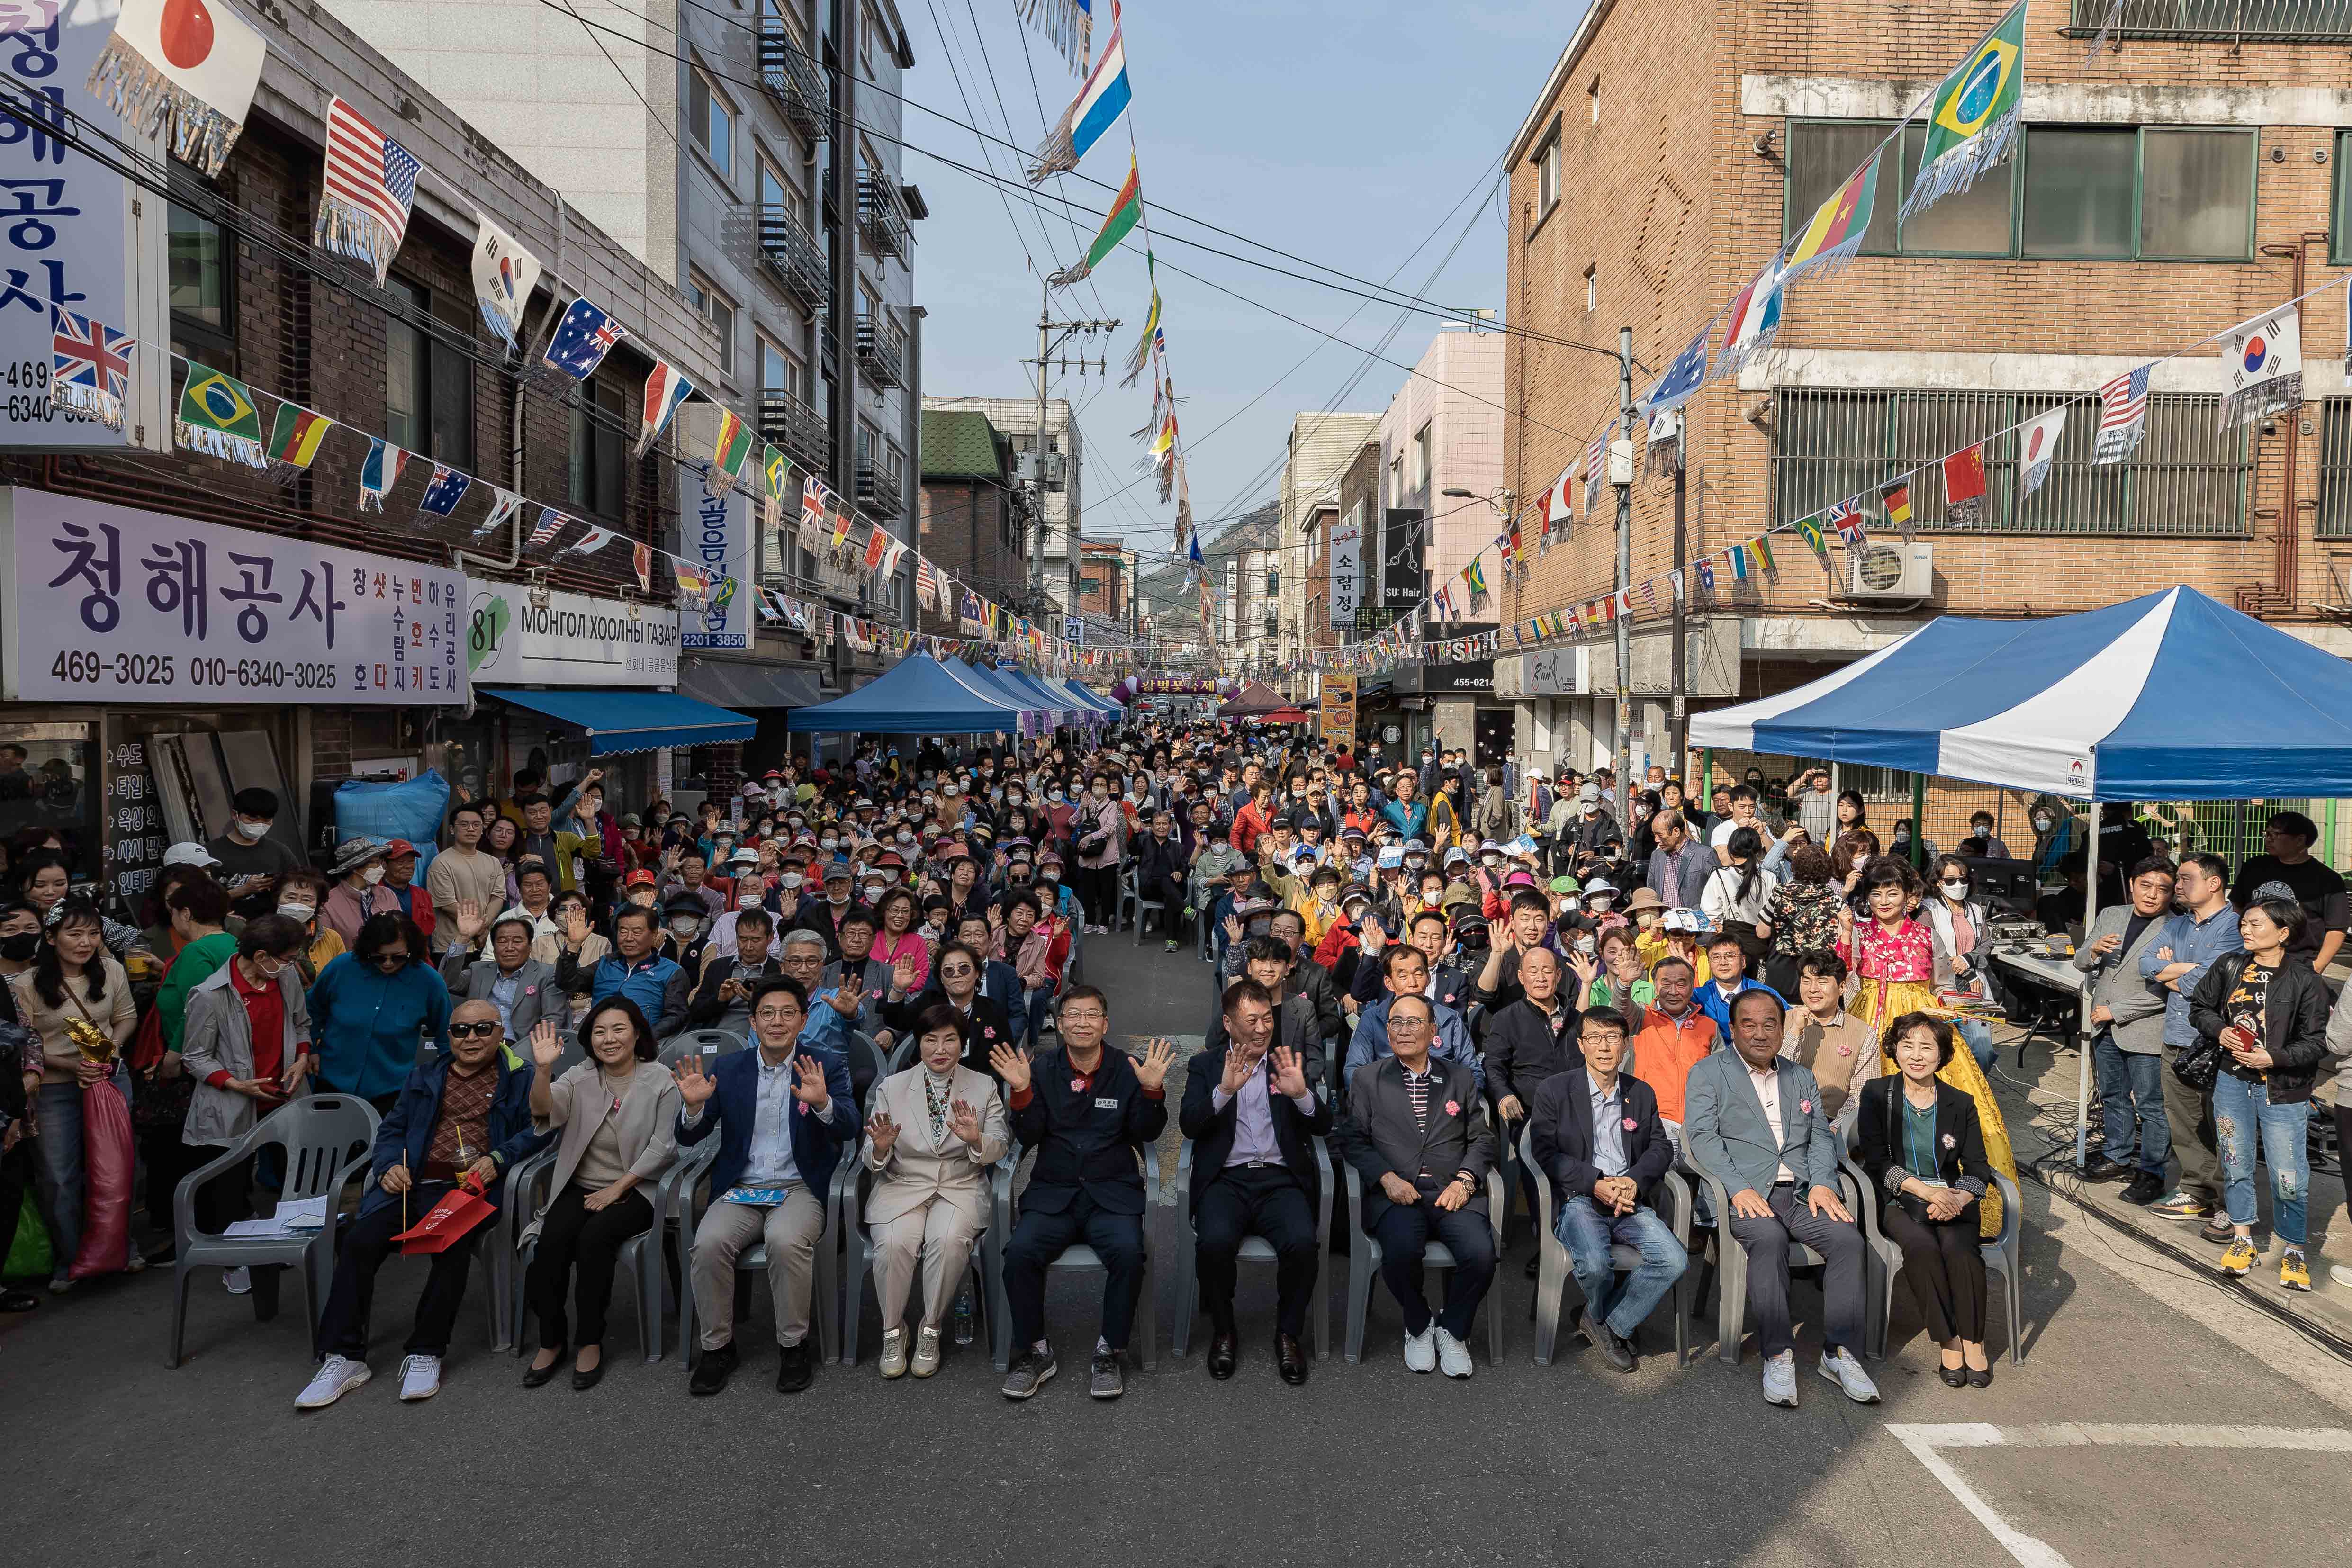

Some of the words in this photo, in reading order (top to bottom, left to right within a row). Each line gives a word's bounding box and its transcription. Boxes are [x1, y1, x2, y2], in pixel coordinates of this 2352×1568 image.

[48, 522, 345, 650] 청해공사
[1402, 587, 1421, 597] Hair
[393, 575, 405, 691] 누수탐지
[411, 578, 423, 691] 번호키
[429, 581, 440, 690] 하수도
[445, 583, 457, 693] 유리공사
[472, 609, 498, 652] 81
[522, 606, 586, 639] МОНГОЛ
[589, 614, 643, 644] ХООЛНЫ
[647, 622, 677, 647] ГАЗАР
[683, 634, 746, 646] 2201-3850
[52, 650, 175, 685] 469-3025
[190, 657, 336, 689] 010-6340-3025
[1453, 678, 1494, 686] 455-0214
[117, 774, 143, 800] 타일
[118, 806, 144, 832] 옥상
[117, 838, 144, 864] 샤시
[118, 866, 163, 896] 인테리
